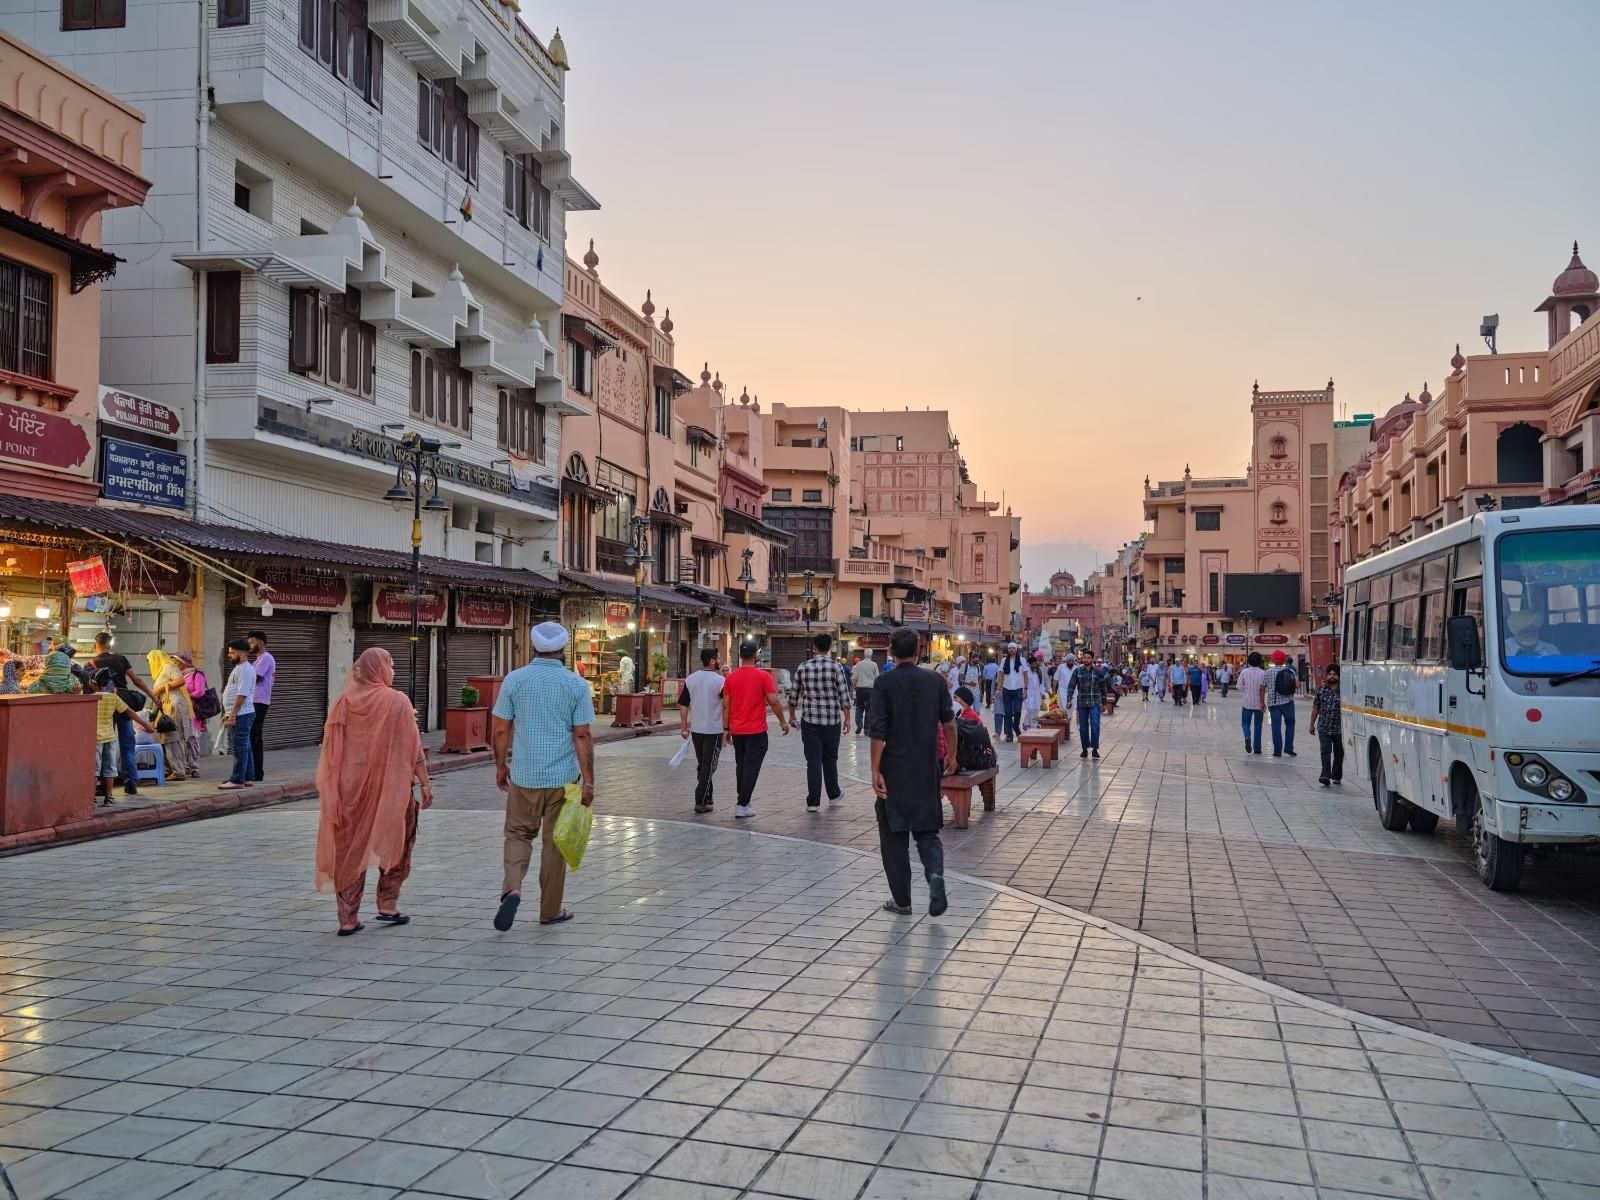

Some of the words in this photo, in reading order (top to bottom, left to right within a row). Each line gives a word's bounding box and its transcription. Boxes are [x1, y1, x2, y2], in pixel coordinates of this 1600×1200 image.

[115, 410, 139, 424] PUNJABI
[140, 416, 154, 428] JUTTI
[154, 420, 170, 432] STORE
[5, 441, 37, 457] POINT
[108, 474, 163, 494] ਰਾਮਦਾਸੀਆਂ
[267, 591, 290, 601] NAVEEN
[291, 593, 318, 604] PRINTERS
